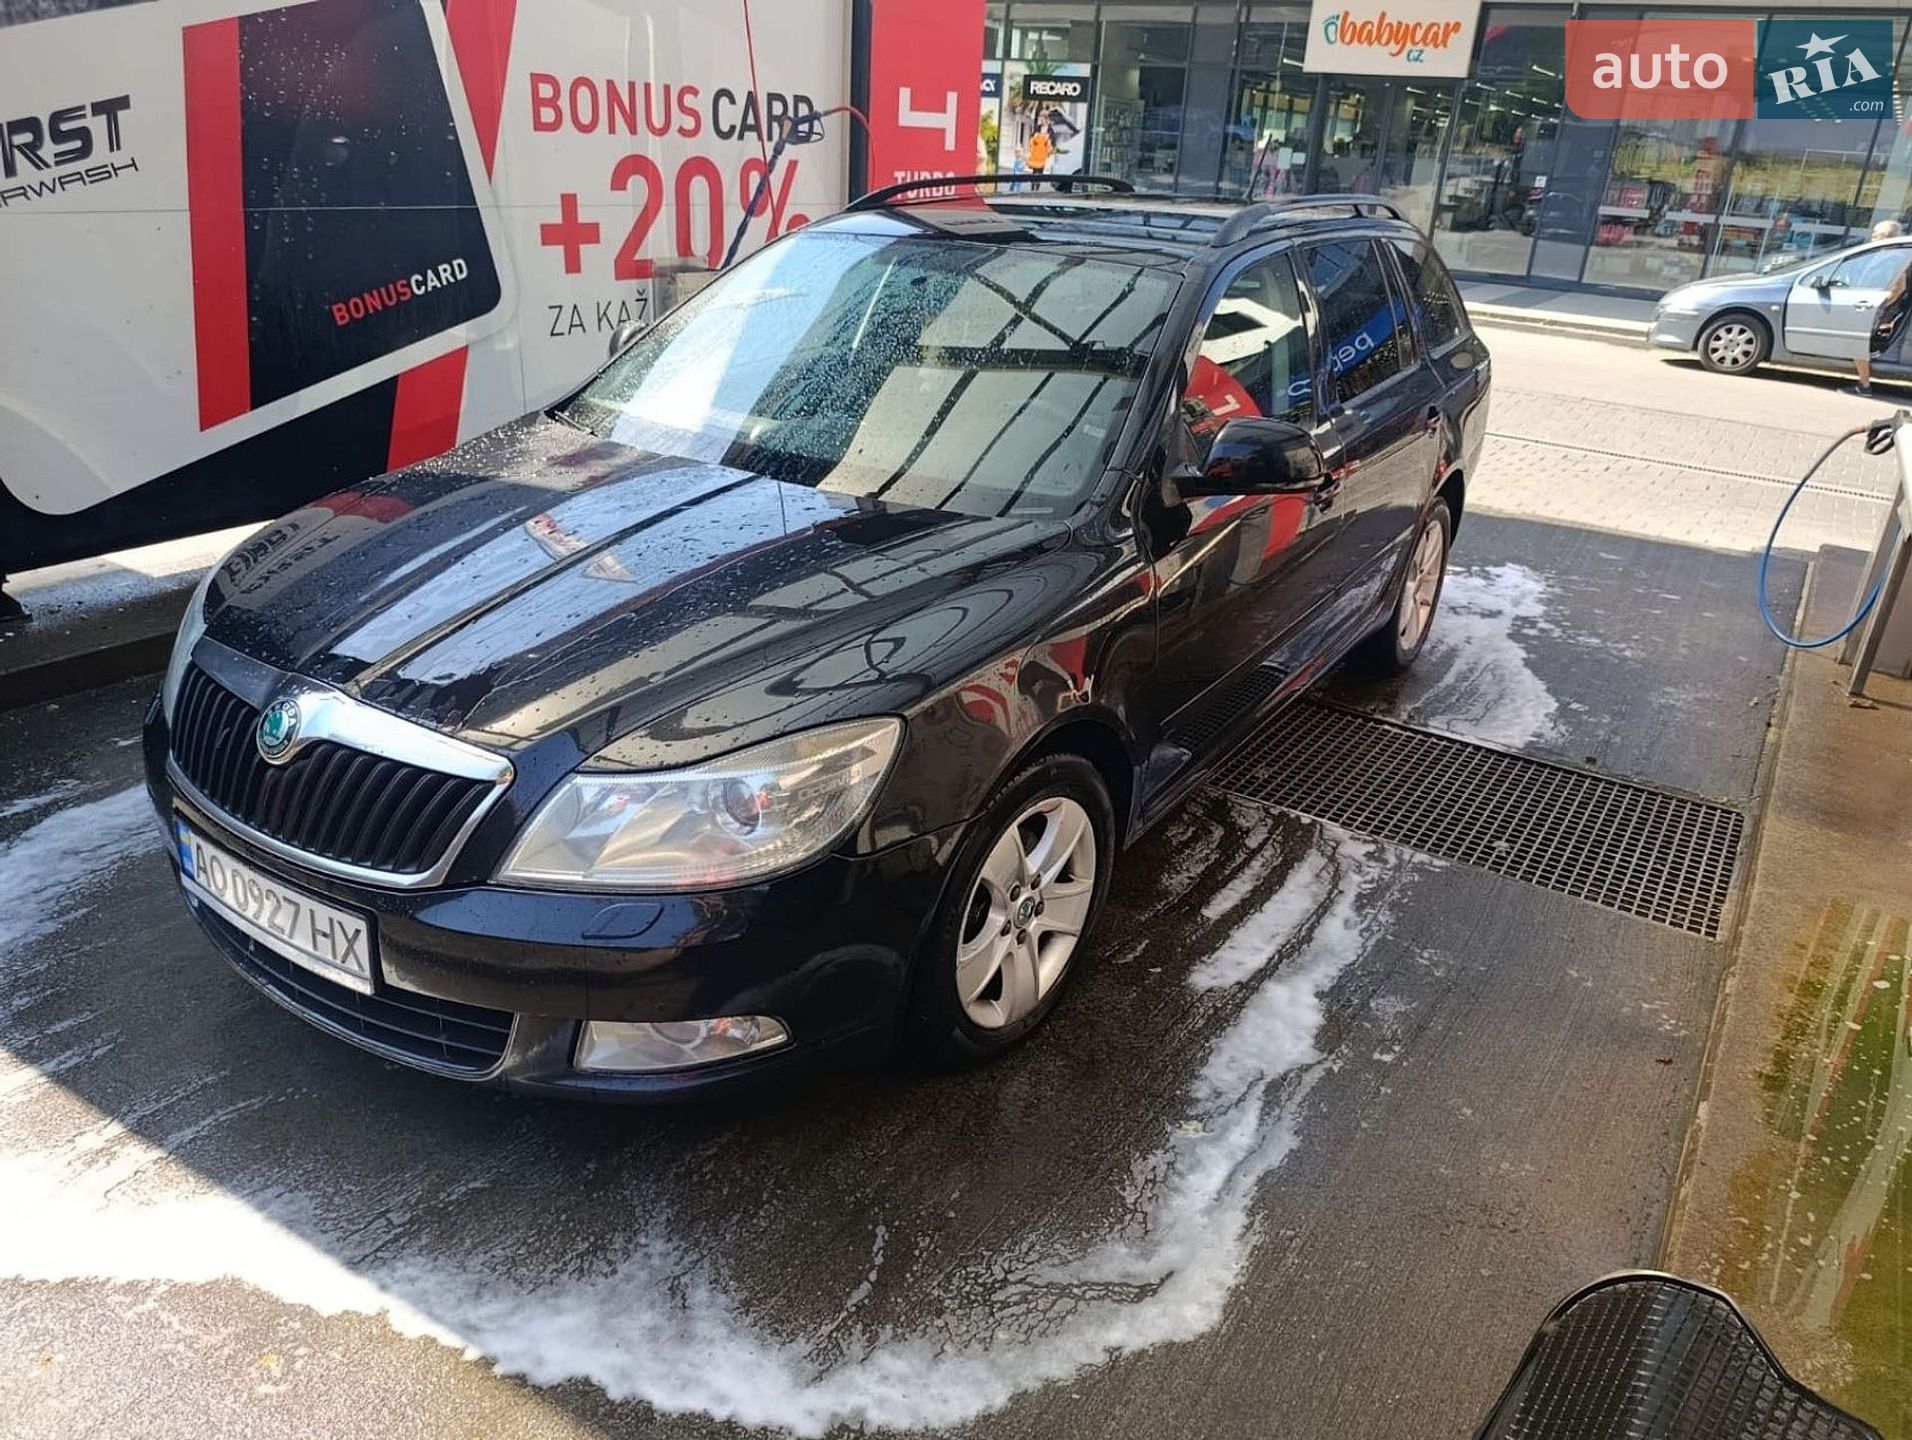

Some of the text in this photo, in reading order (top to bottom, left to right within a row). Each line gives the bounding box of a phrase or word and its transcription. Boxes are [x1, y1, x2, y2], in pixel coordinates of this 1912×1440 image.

[1339, 10, 1461, 57] babycar
[530, 73, 814, 142] BONUS CARD
[1029, 80, 1081, 96] RECARO
[899, 86, 958, 151] 4
[0, 157, 139, 208] RWASH
[540, 154, 811, 281] +20%
[548, 304, 586, 337] ZA
[196, 843, 367, 972] AO 0927 HX
